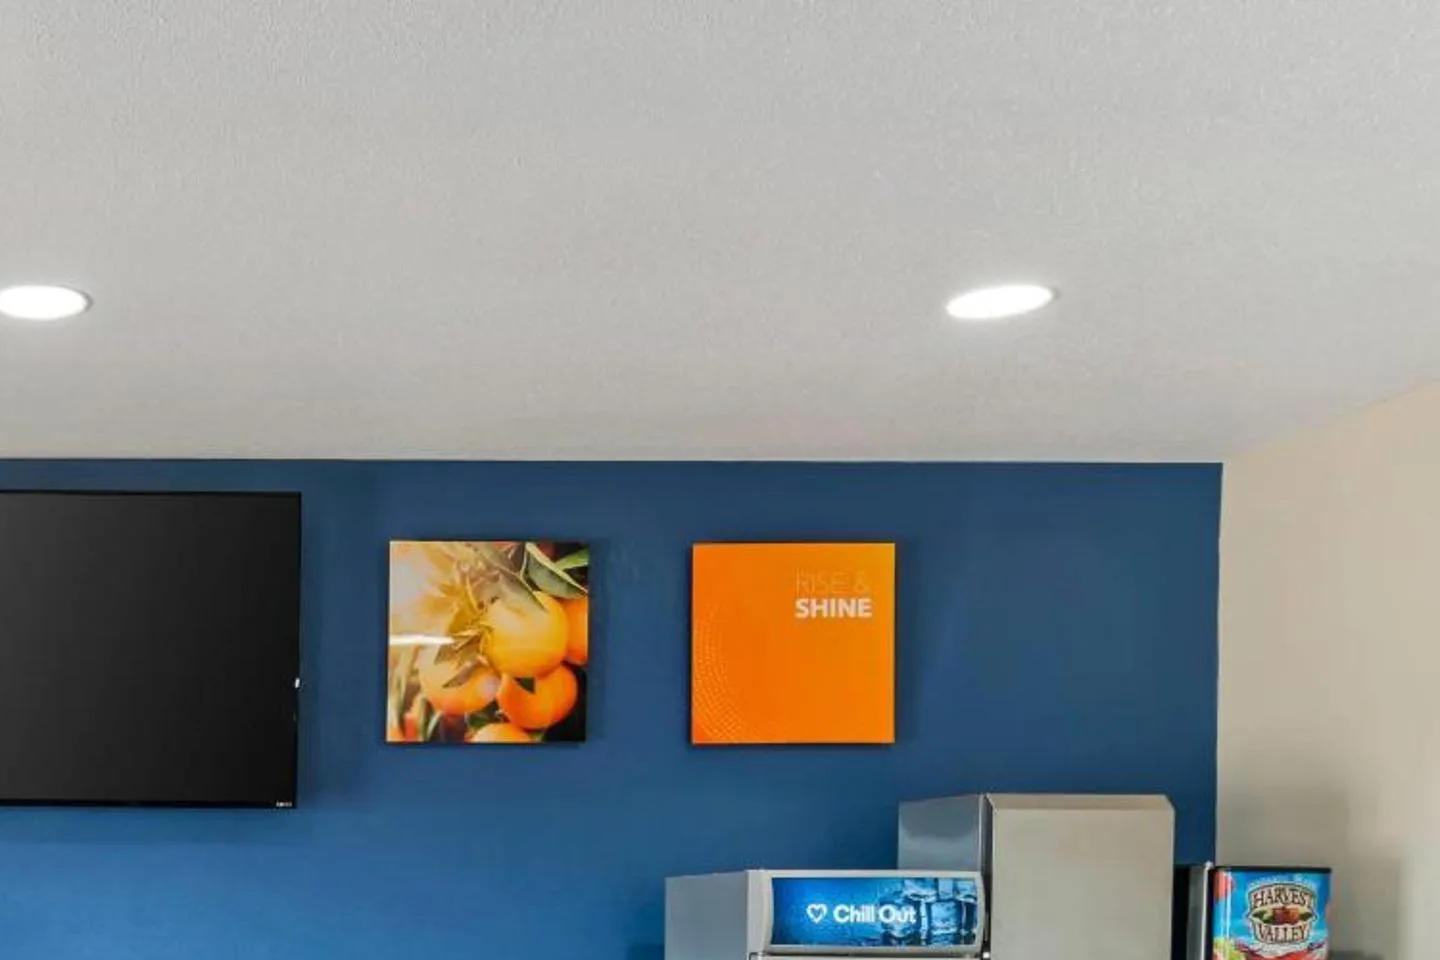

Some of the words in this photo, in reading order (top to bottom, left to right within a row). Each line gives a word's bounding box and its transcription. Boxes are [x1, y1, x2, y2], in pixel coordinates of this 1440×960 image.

[796, 570, 848, 594] RISE
[855, 571, 870, 594] &
[794, 597, 873, 619] SHINE
[1252, 887, 1312, 909] HARVEST
[833, 903, 875, 923] Chill
[879, 903, 917, 924] Out
[1258, 923, 1306, 944] VALLEY
